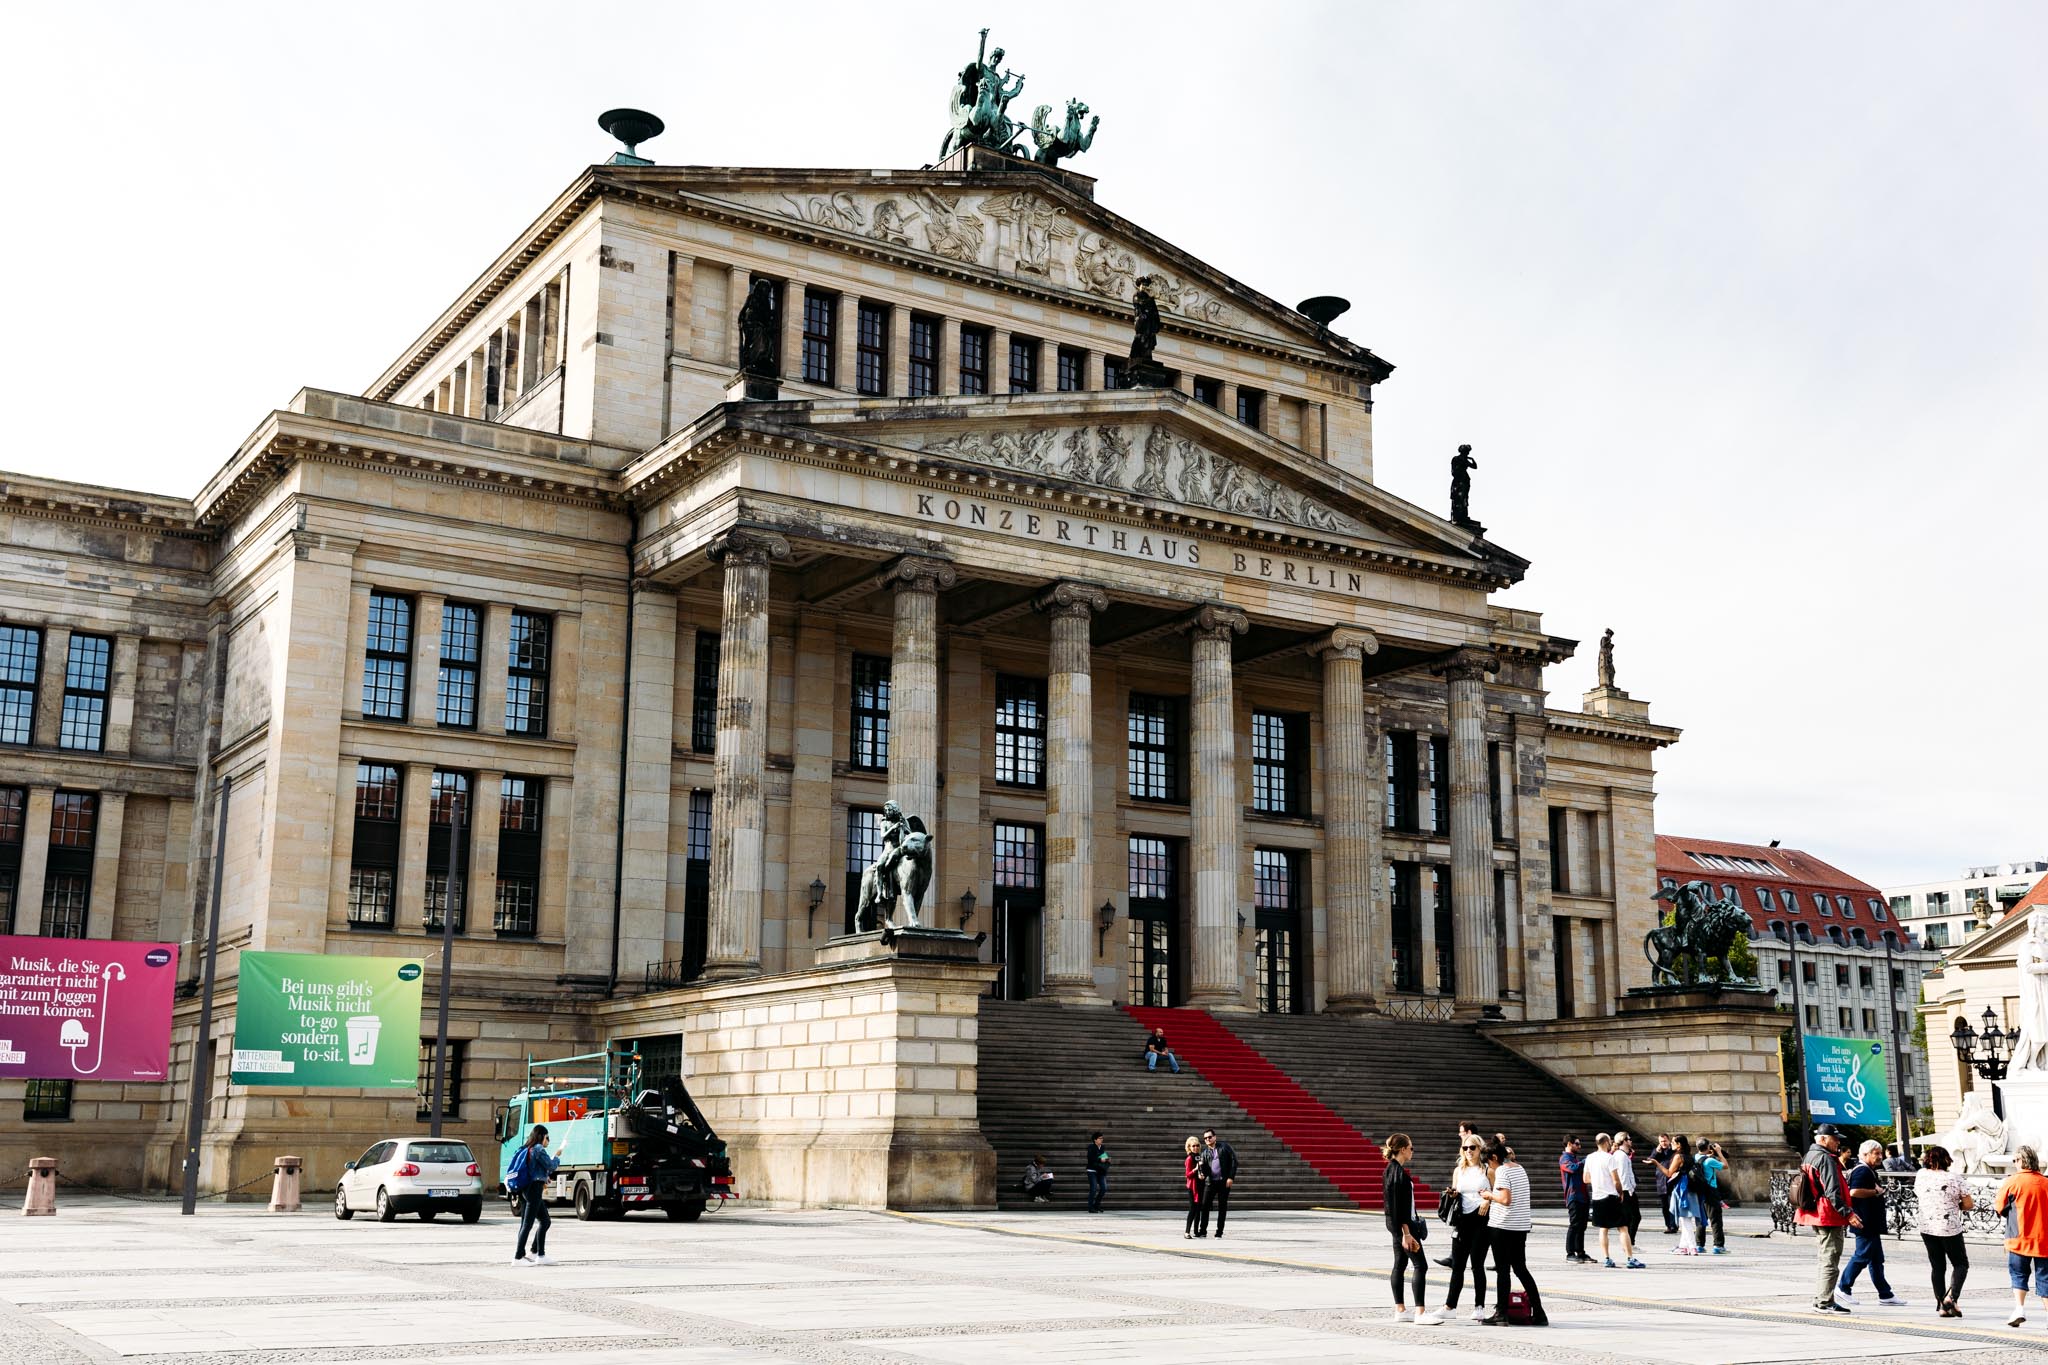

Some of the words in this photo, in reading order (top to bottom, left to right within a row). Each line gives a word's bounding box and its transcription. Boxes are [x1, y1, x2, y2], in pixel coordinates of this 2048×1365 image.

[917, 494, 1200, 564] KONZERTHAUS
[1233, 553, 1361, 592] BERLIN
[10, 956, 55, 973] Musik,
[58, 958, 78, 973] die
[81, 960, 100, 974] Sie
[65, 975, 98, 989] nicht
[281, 978, 304, 993] Bei
[307, 984, 334, 995] uns
[337, 980, 373, 1000] gibt's
[20, 991, 50, 1001] zum
[51, 988, 97, 1006] Joggen
[288, 995, 332, 1012] Musik
[336, 998, 371, 1013] nicht
[43, 1002, 95, 1018] können.
[301, 1014, 337, 1032] to-go
[281, 1028, 339, 1045] sondern
[238, 1051, 281, 1061] MITTENDRIN
[303, 1047, 344, 1062] to-sit.
[237, 1061, 258, 1071] STATT
